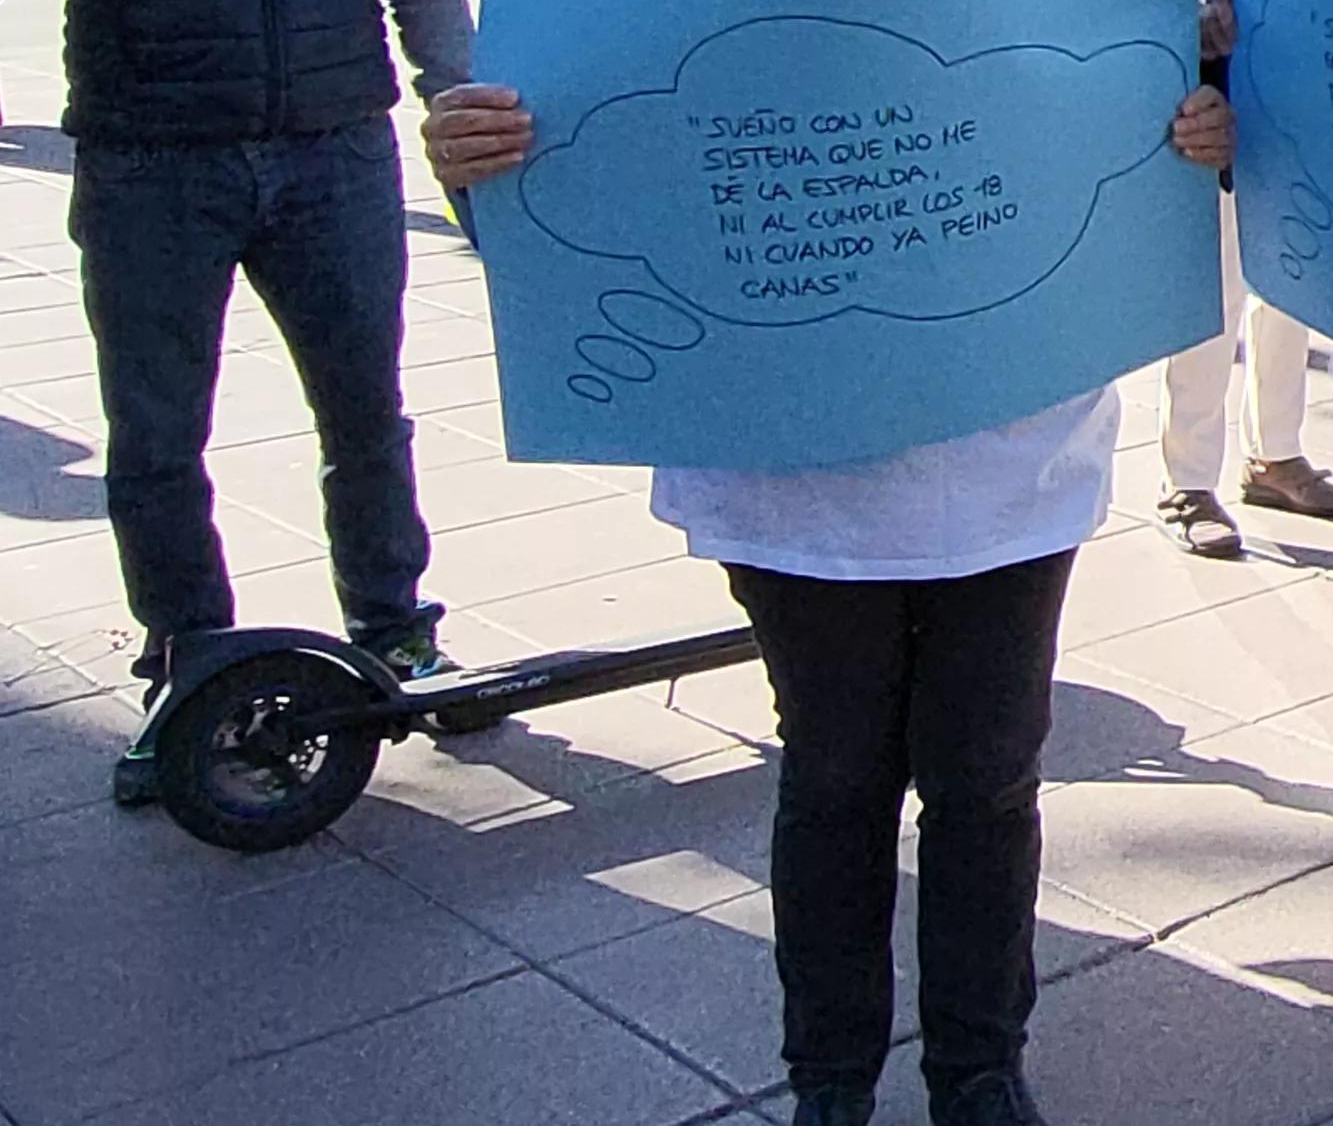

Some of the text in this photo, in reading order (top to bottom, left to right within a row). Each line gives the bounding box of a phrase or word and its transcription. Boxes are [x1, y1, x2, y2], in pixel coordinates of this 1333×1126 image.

[810, 111, 863, 134] CON
[874, 105, 913, 125] UN
[702, 120, 977, 172] SISTEMA QUE NO ME
[720, 214, 745, 236] NI
[761, 214, 797, 234] AL
[807, 198, 914, 230] CUMPLIR
[923, 186, 964, 214] LOS
[757, 181, 793, 202] LA
[724, 203, 1018, 265] NI CUANDO YA PEINO
